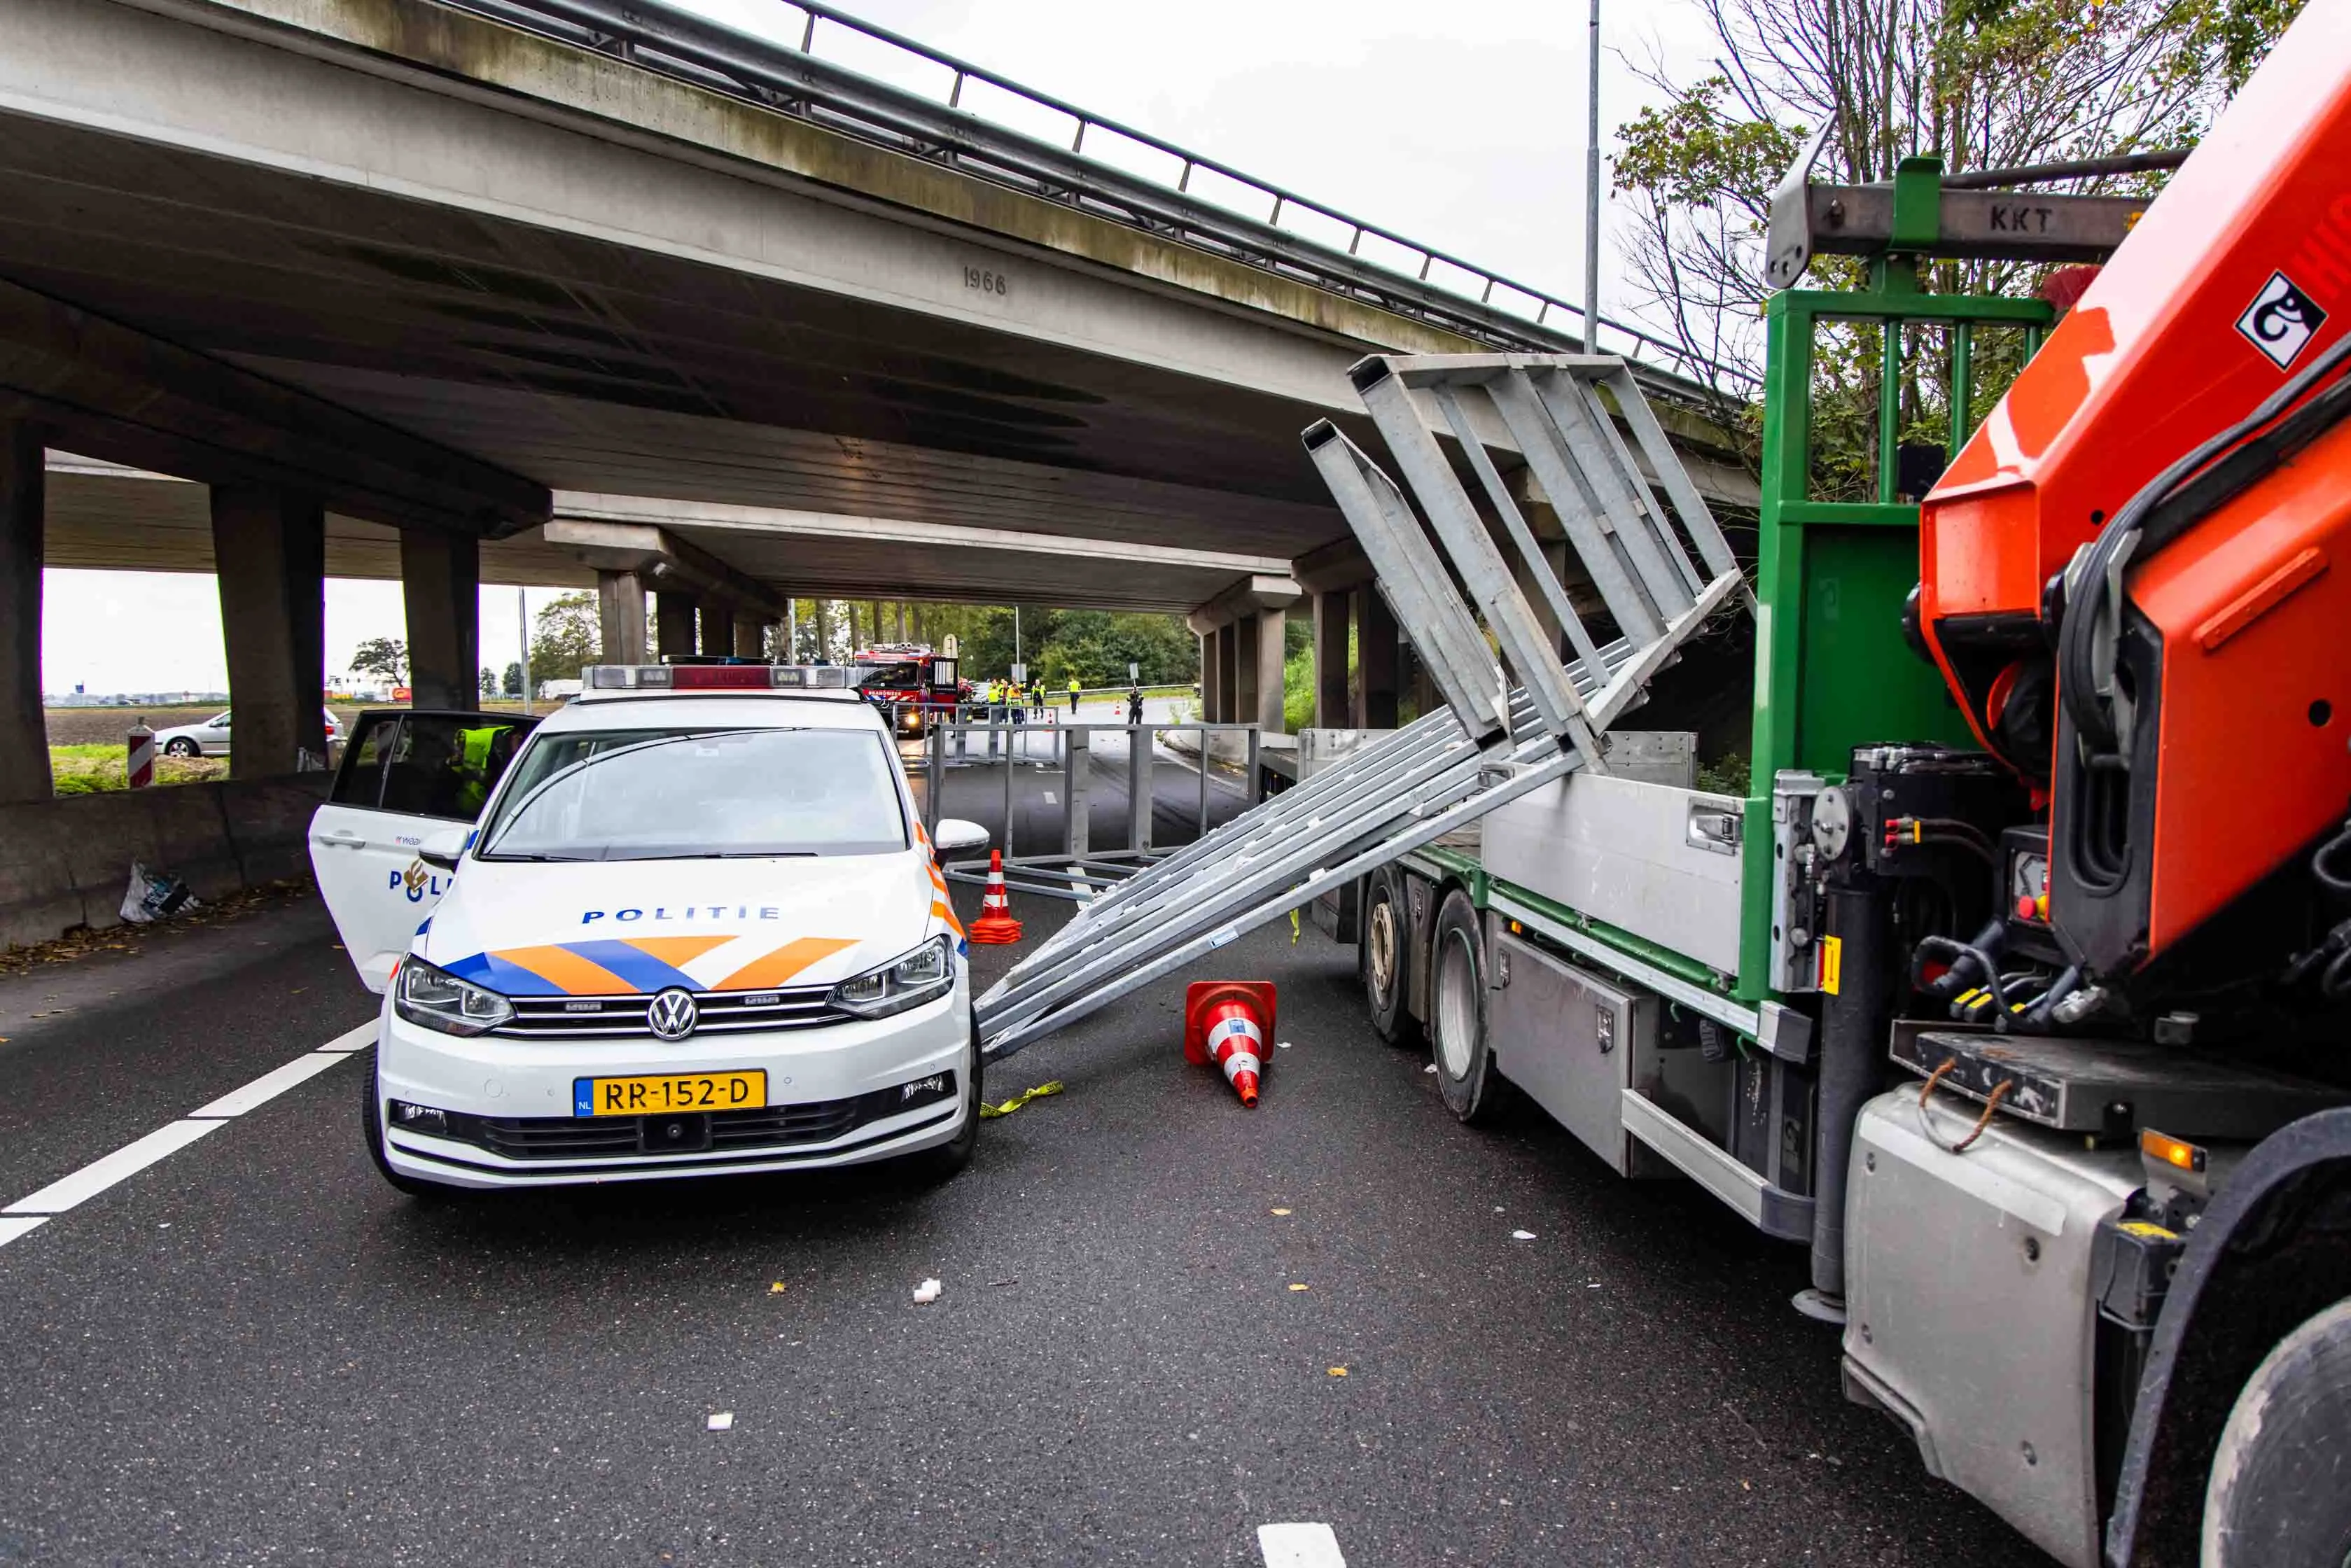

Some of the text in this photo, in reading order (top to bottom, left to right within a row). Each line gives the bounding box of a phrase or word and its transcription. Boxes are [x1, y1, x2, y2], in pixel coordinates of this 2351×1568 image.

[1990, 205, 2053, 233] KKT
[964, 265, 1007, 295] 1966
[582, 906, 780, 924] POLITIE
[578, 1101, 592, 1110] NL
[606, 1077, 749, 1110] RR-152-D
